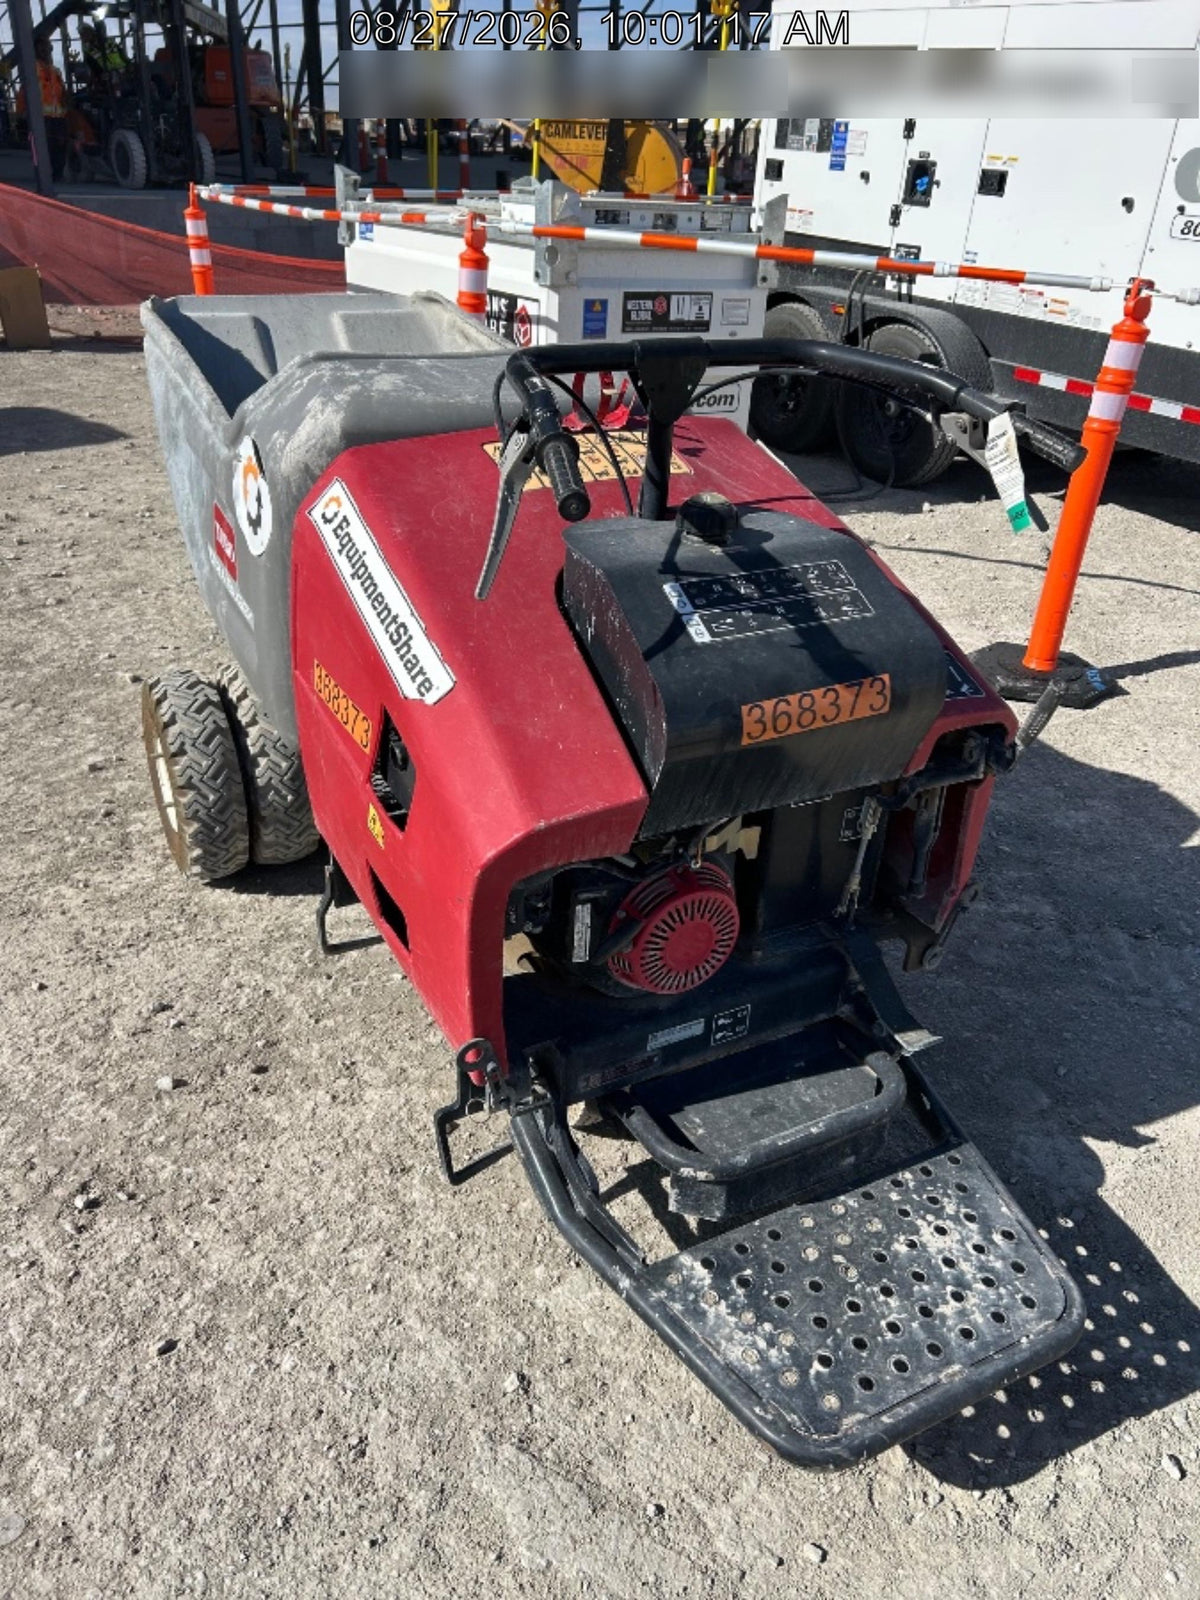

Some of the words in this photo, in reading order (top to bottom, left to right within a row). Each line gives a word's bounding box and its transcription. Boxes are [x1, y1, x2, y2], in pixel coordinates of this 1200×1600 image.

[331, 514, 435, 698] EquipmentShare
[316, 663, 370, 749] 368373
[746, 676, 888, 741] 368373
